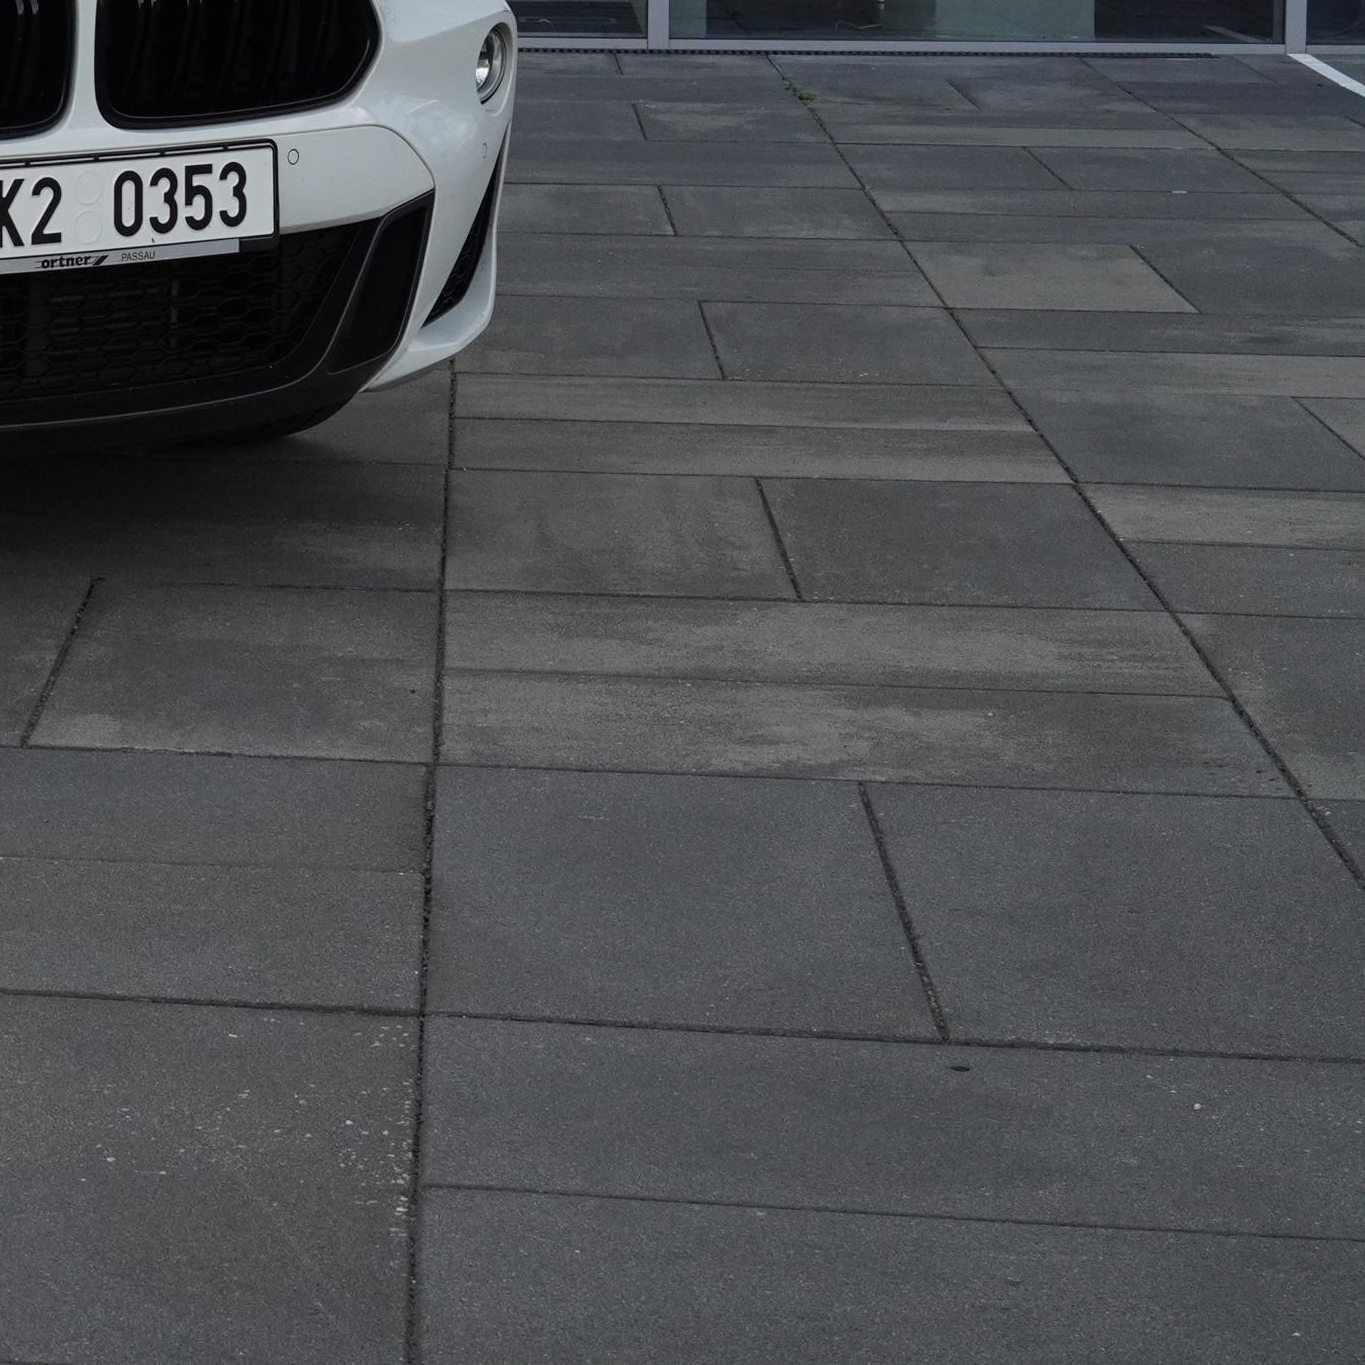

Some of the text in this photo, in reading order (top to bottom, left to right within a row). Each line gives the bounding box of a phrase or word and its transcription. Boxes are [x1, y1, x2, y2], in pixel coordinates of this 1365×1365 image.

[113, 162, 248, 237] 0353
[41, 250, 156, 269] ortner PASSAU
